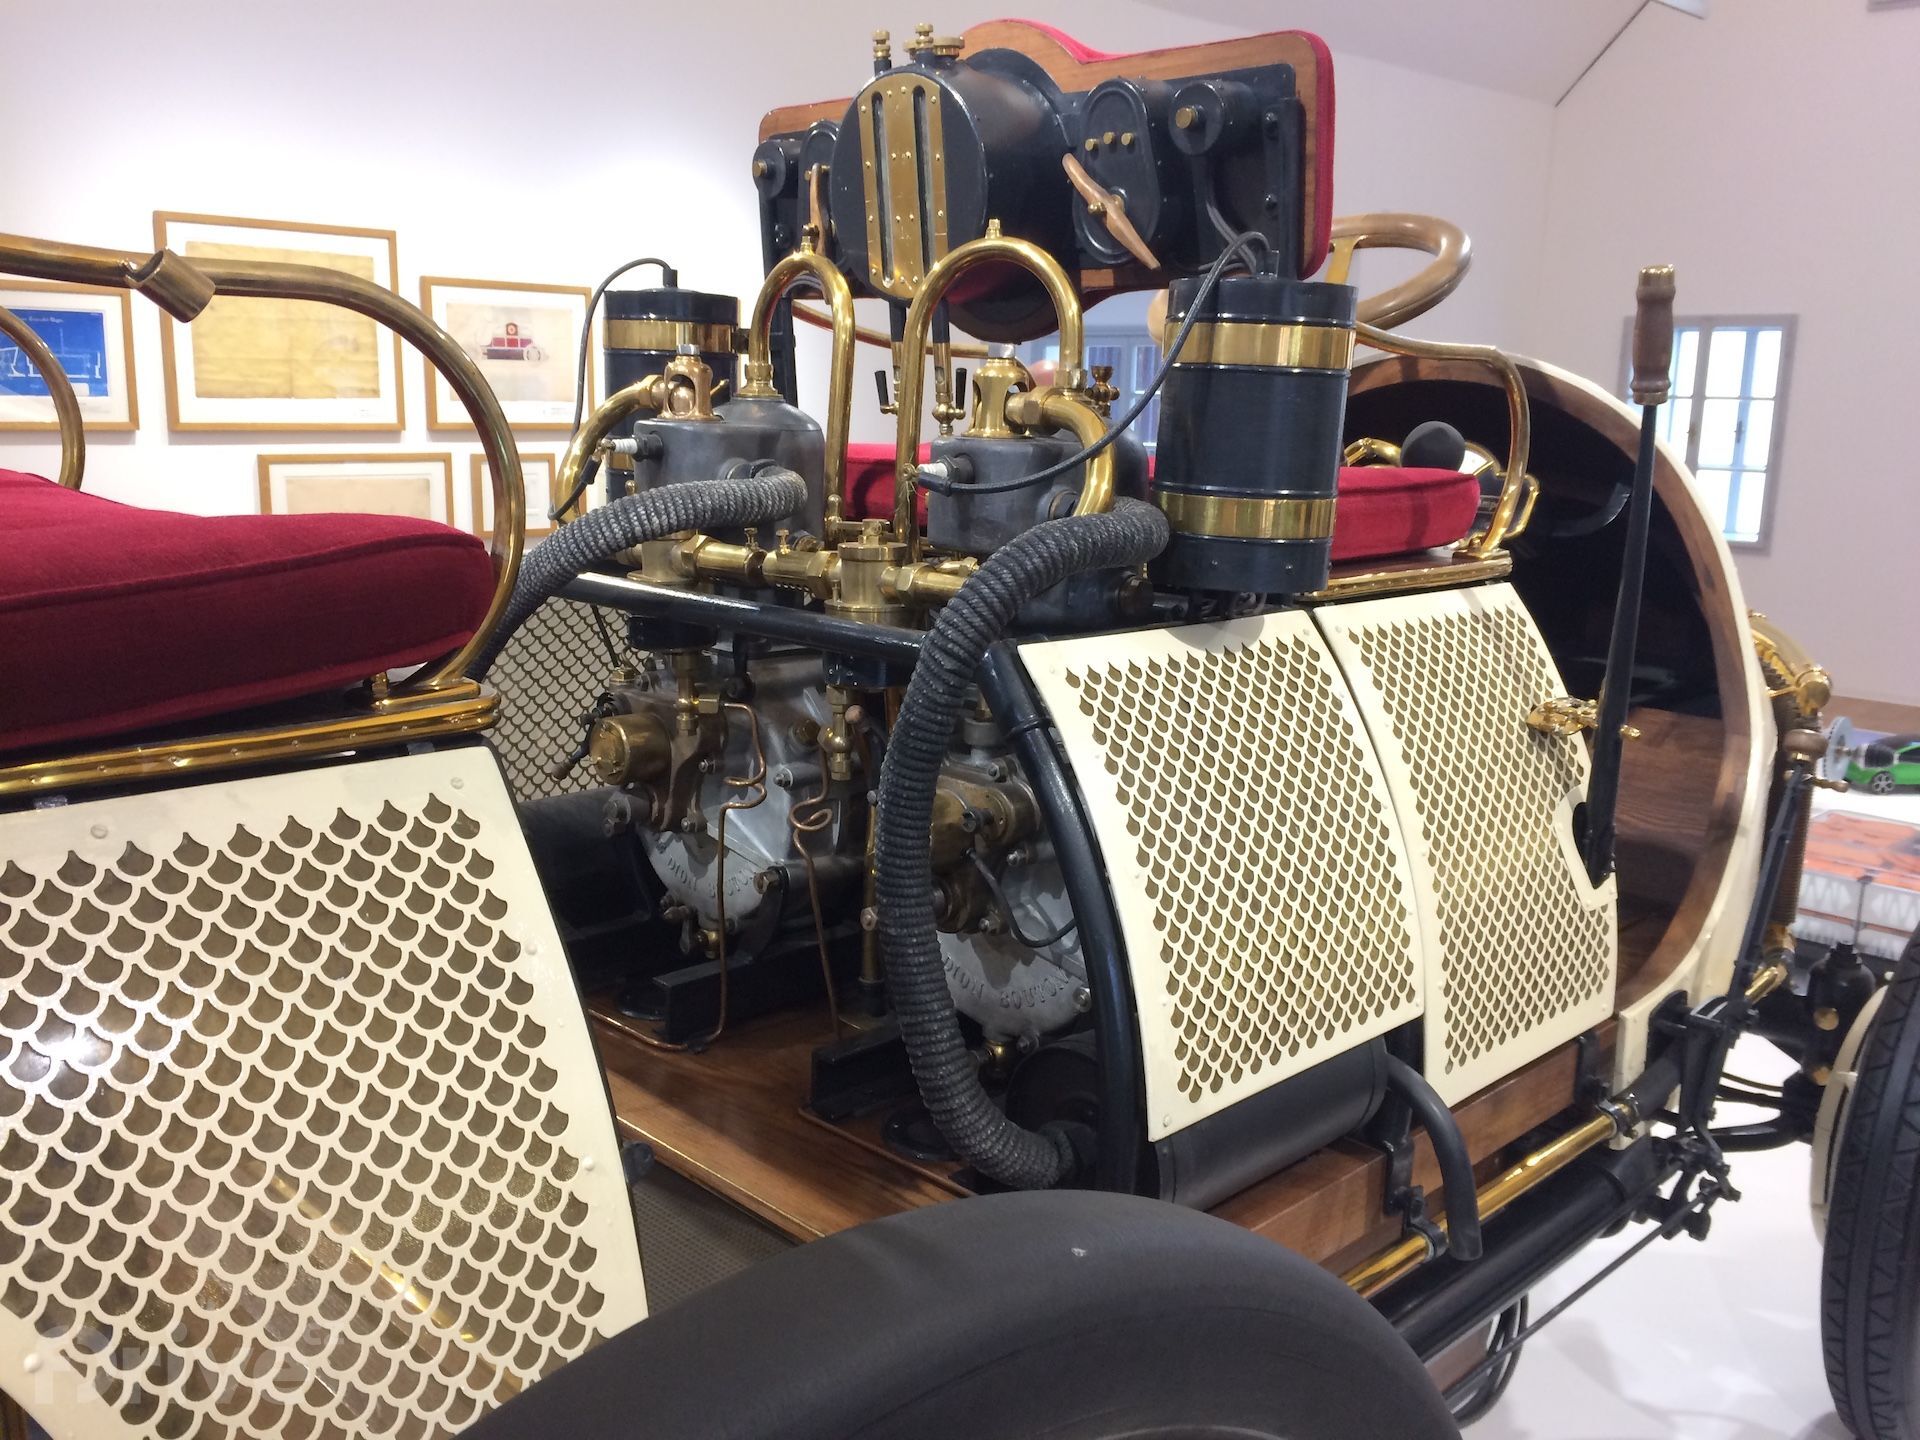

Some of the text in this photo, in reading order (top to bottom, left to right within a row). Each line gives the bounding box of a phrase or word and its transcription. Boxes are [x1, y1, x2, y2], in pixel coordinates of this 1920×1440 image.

[667, 857, 698, 892] DION
[943, 956, 1069, 1010] DION BOUTON
